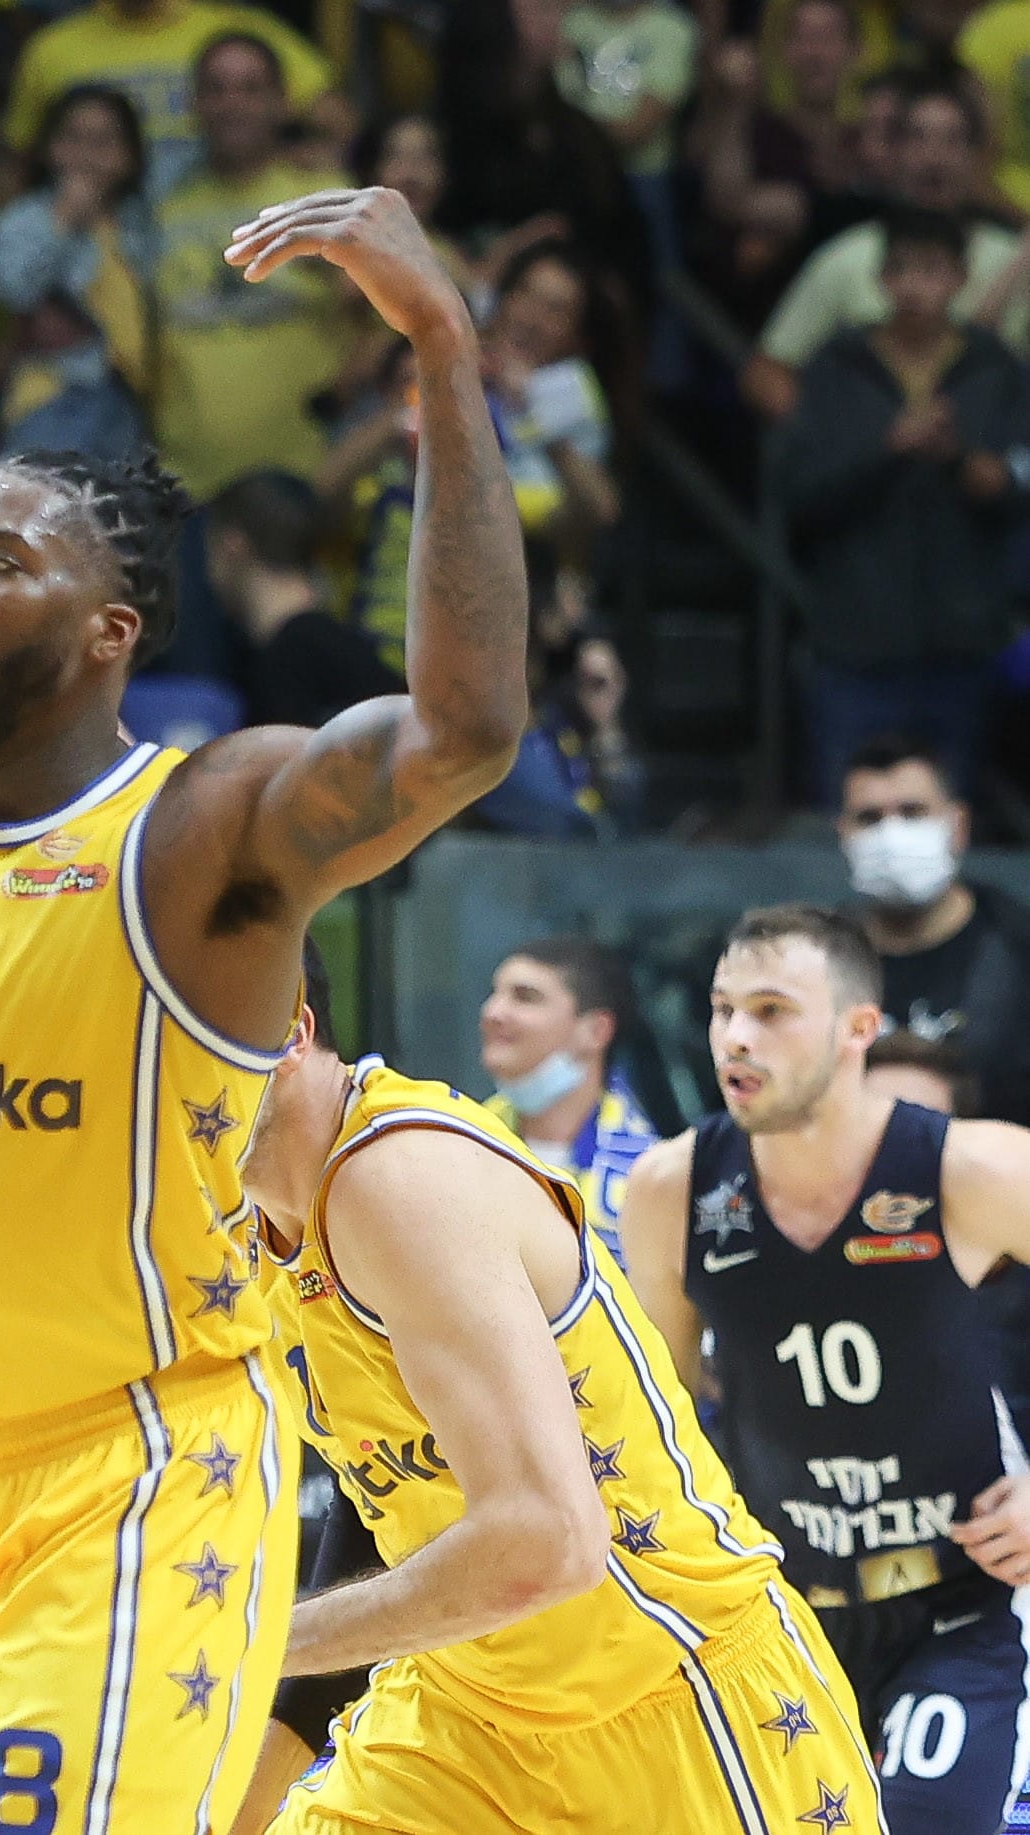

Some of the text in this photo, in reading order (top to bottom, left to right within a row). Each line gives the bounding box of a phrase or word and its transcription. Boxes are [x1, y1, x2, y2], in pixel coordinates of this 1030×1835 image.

[775, 1320, 884, 1408] 10
[806, 1454, 901, 1505] יוסי
[880, 1692, 967, 1780] 10
